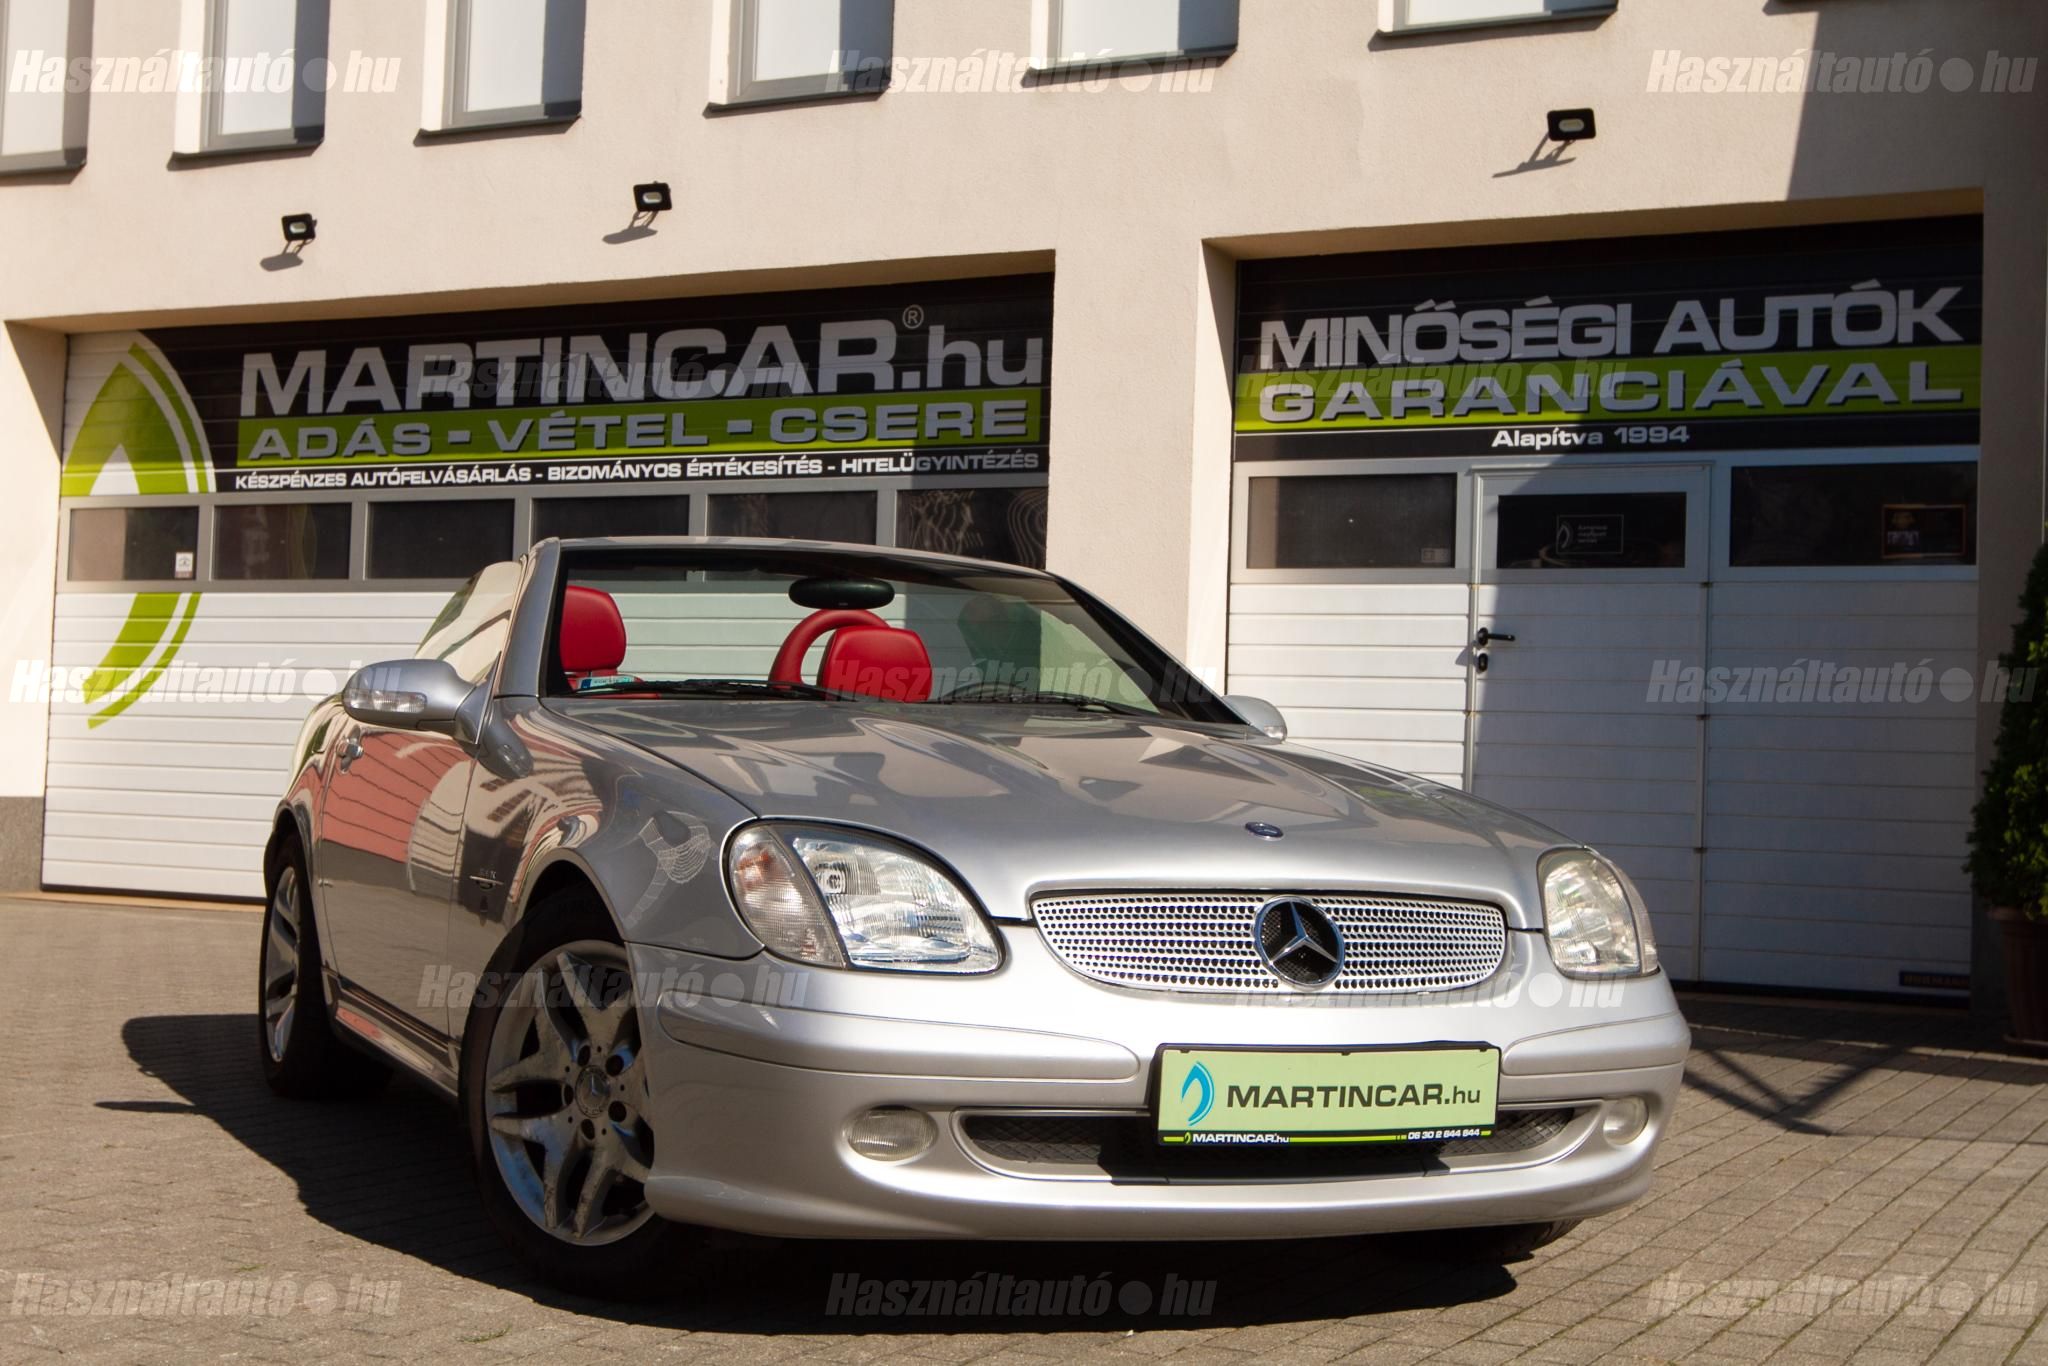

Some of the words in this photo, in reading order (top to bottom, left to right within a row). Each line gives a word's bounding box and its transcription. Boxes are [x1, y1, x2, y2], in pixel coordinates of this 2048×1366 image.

[1259, 295, 1633, 370] MINŐSÉGI
[1653, 278, 1965, 354] AUTÓK
[1259, 359, 1963, 424] GARANCIÁVAL
[248, 418, 432, 460] ADÁS
[487, 410, 708, 453] VÉTEL
[770, 400, 1029, 444] CSERE
[1492, 427, 1604, 452] Alapítva
[1613, 425, 1691, 445] 1994
[235, 471, 348, 489] KÉSZPÉNZES
[350, 464, 532, 486] AUTÓFELVÁSÁRLÁS
[548, 460, 681, 481] BIZOMÁNYOS
[687, 456, 823, 477] ÉRTÉKESÍTÉS
[841, 450, 1039, 473] HITELÜGYINTÉZÉS
[1226, 1082, 1481, 1109] MARTINCAR.hu
[1407, 1131, 1421, 1140] 06
[1422, 1130, 1434, 1139] 30
